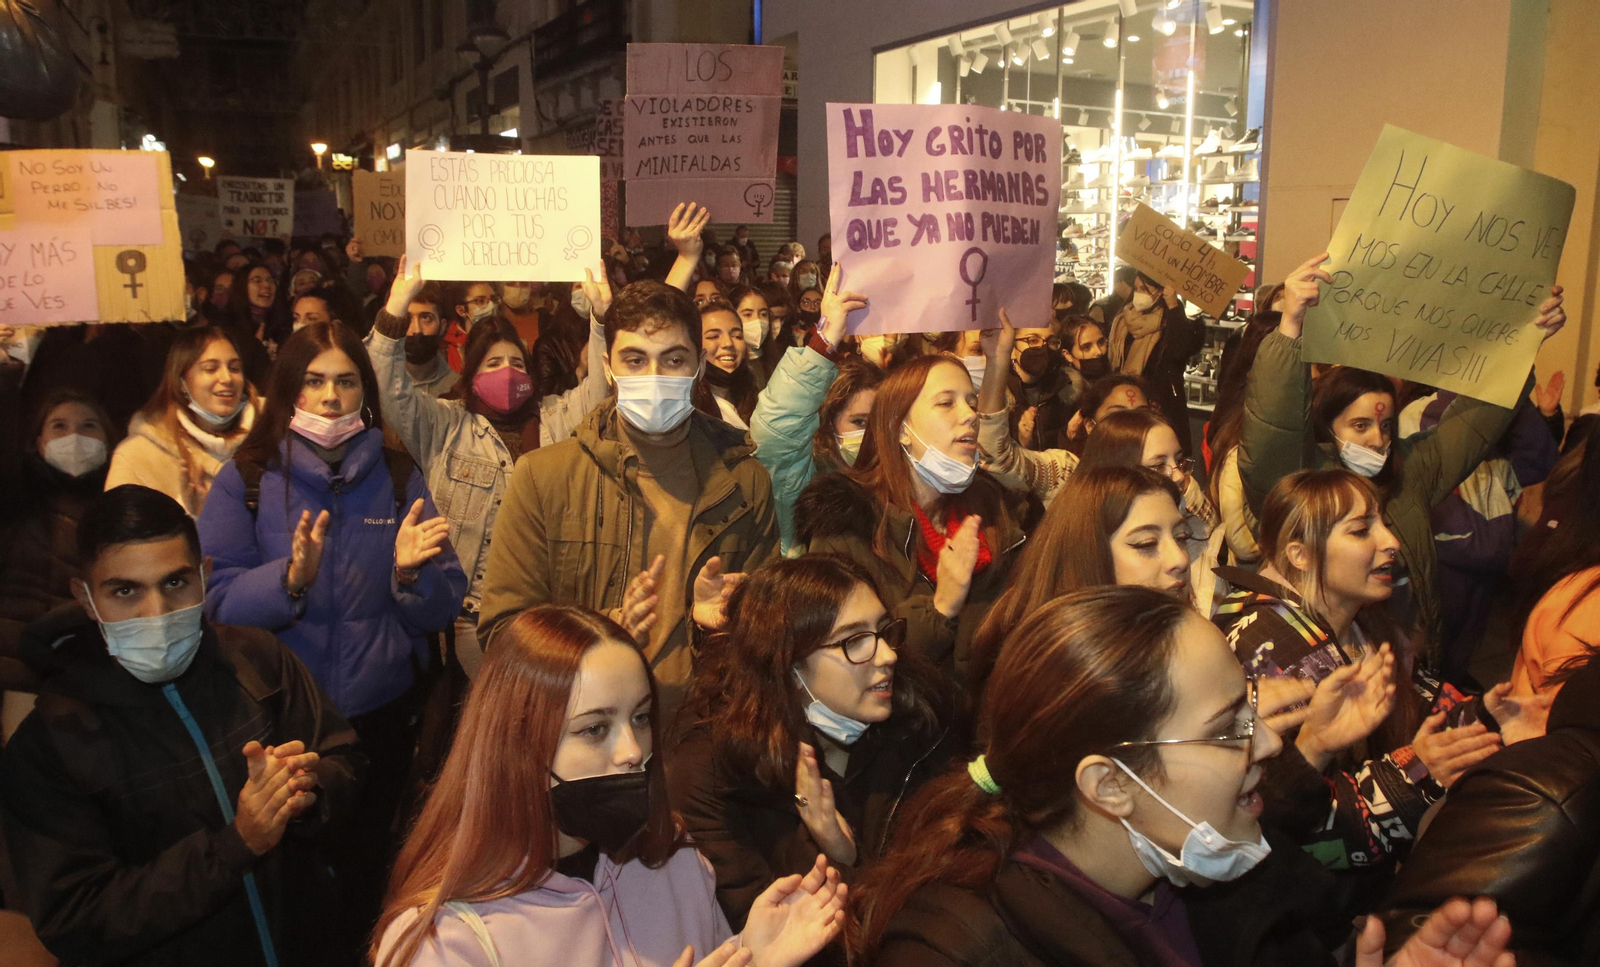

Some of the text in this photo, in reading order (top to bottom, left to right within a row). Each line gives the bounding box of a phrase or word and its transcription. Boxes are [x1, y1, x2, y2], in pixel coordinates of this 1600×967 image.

[685, 49, 733, 82] LOS
[630, 96, 754, 115] VIOLADORES
[662, 116, 738, 129] EXISTIERON
[637, 134, 743, 149] ANTES QUE LAS
[1012, 130, 1048, 164] POR
[19, 160, 47, 175] NO
[430, 155, 555, 184] ESTÁS PRECIOSA
[635, 154, 742, 177] MINIFALDAS
[228, 189, 285, 204] TRADUCTOR
[433, 184, 568, 212] CUANDO LUCHAS
[847, 168, 1049, 207] LAS HERMANAS
[1378, 148, 1456, 234] HOY
[1464, 210, 1525, 252] NOS
[462, 213, 545, 240] POR TUS
[846, 210, 1041, 253] QUE YA NO PUEDEN
[30, 236, 78, 270] MÁS
[461, 241, 539, 267] DERECHOS
[1133, 225, 1169, 260] VIOLA
[1166, 255, 1181, 268] UN
[1179, 257, 1228, 297] HOMBRE
[22, 270, 46, 287] LO
[1347, 232, 1545, 308] MOS EN LA CALLE
[21, 288, 66, 310] VES
[1182, 279, 1215, 304] SEXO
[1323, 269, 1409, 317] PORQUE
[1414, 302, 1456, 330] NOS
[1333, 320, 1374, 342] MOS
